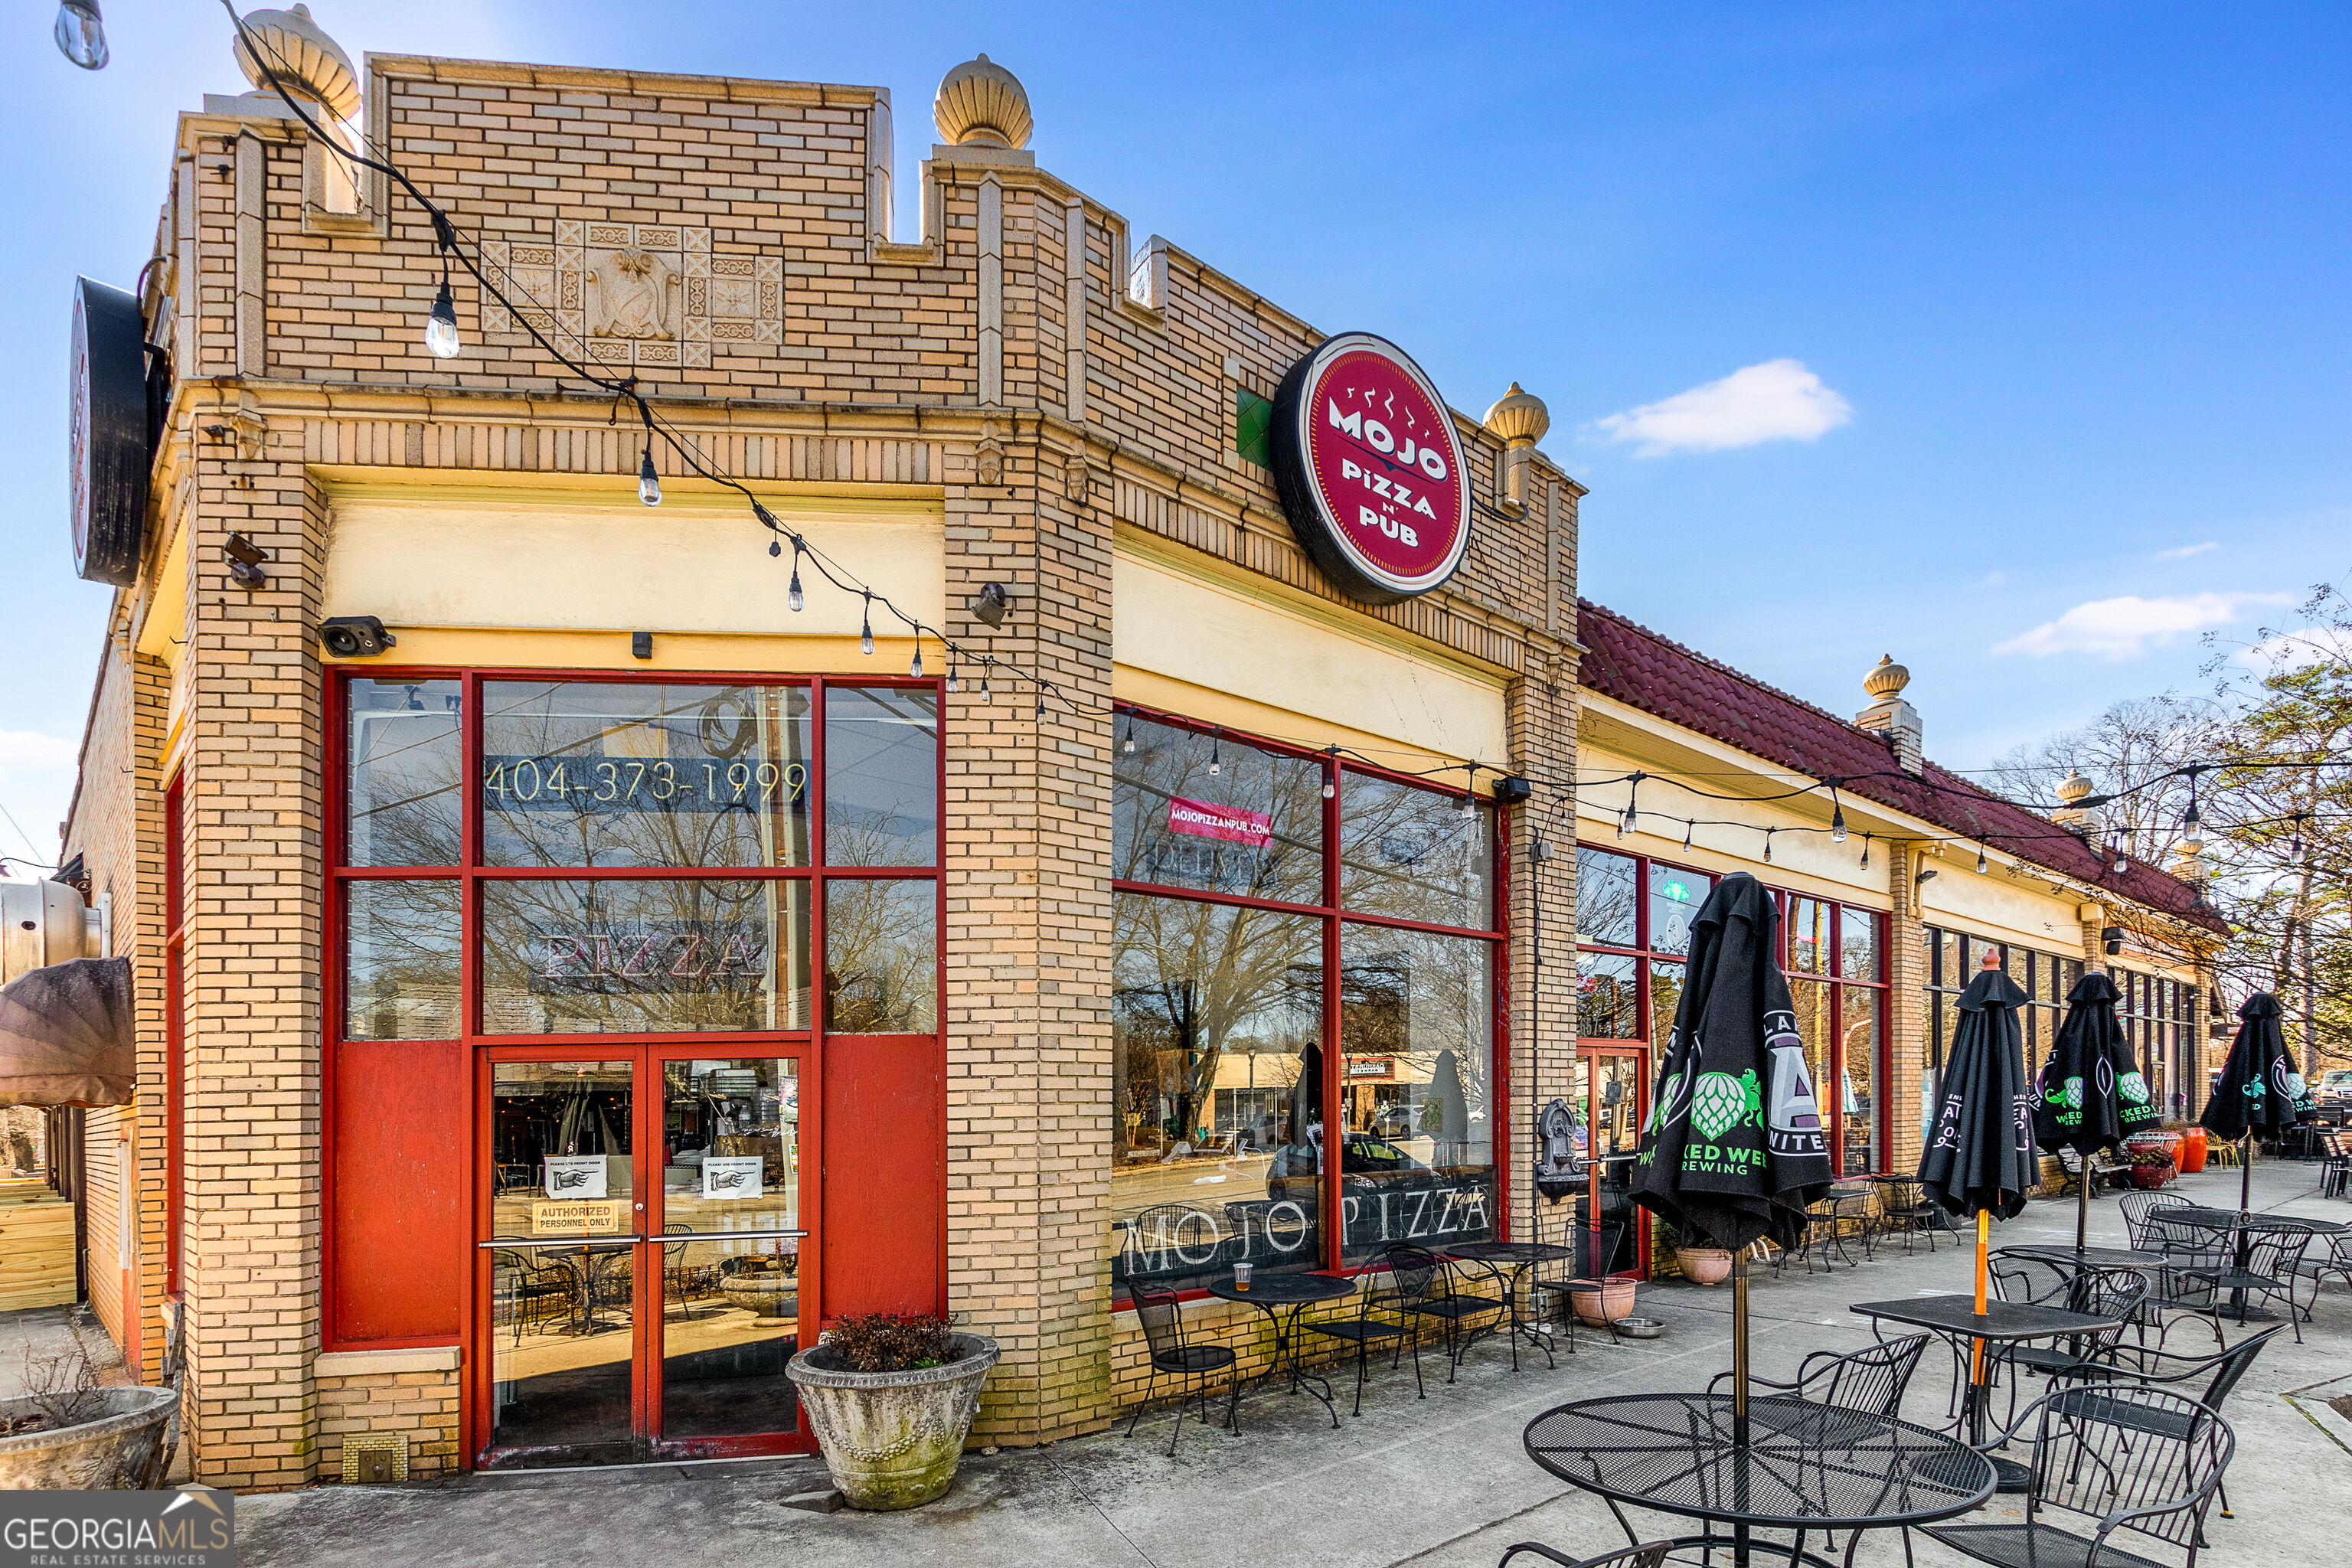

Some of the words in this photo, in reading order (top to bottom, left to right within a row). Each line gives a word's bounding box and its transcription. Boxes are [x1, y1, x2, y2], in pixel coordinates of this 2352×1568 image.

[1329, 397, 1447, 482] MOJO
[1359, 505, 1419, 547] PUB
[485, 760, 808, 802] 404-373-1999
[539, 934, 767, 978] PIZZA
[540, 1218, 587, 1228] PERSONNEL
[590, 1217, 611, 1227] ONLY
[541, 1207, 611, 1218] AUTHORIZED
[1123, 1200, 1306, 1276] MOJO
[1341, 1185, 1490, 1246] PIZZA
